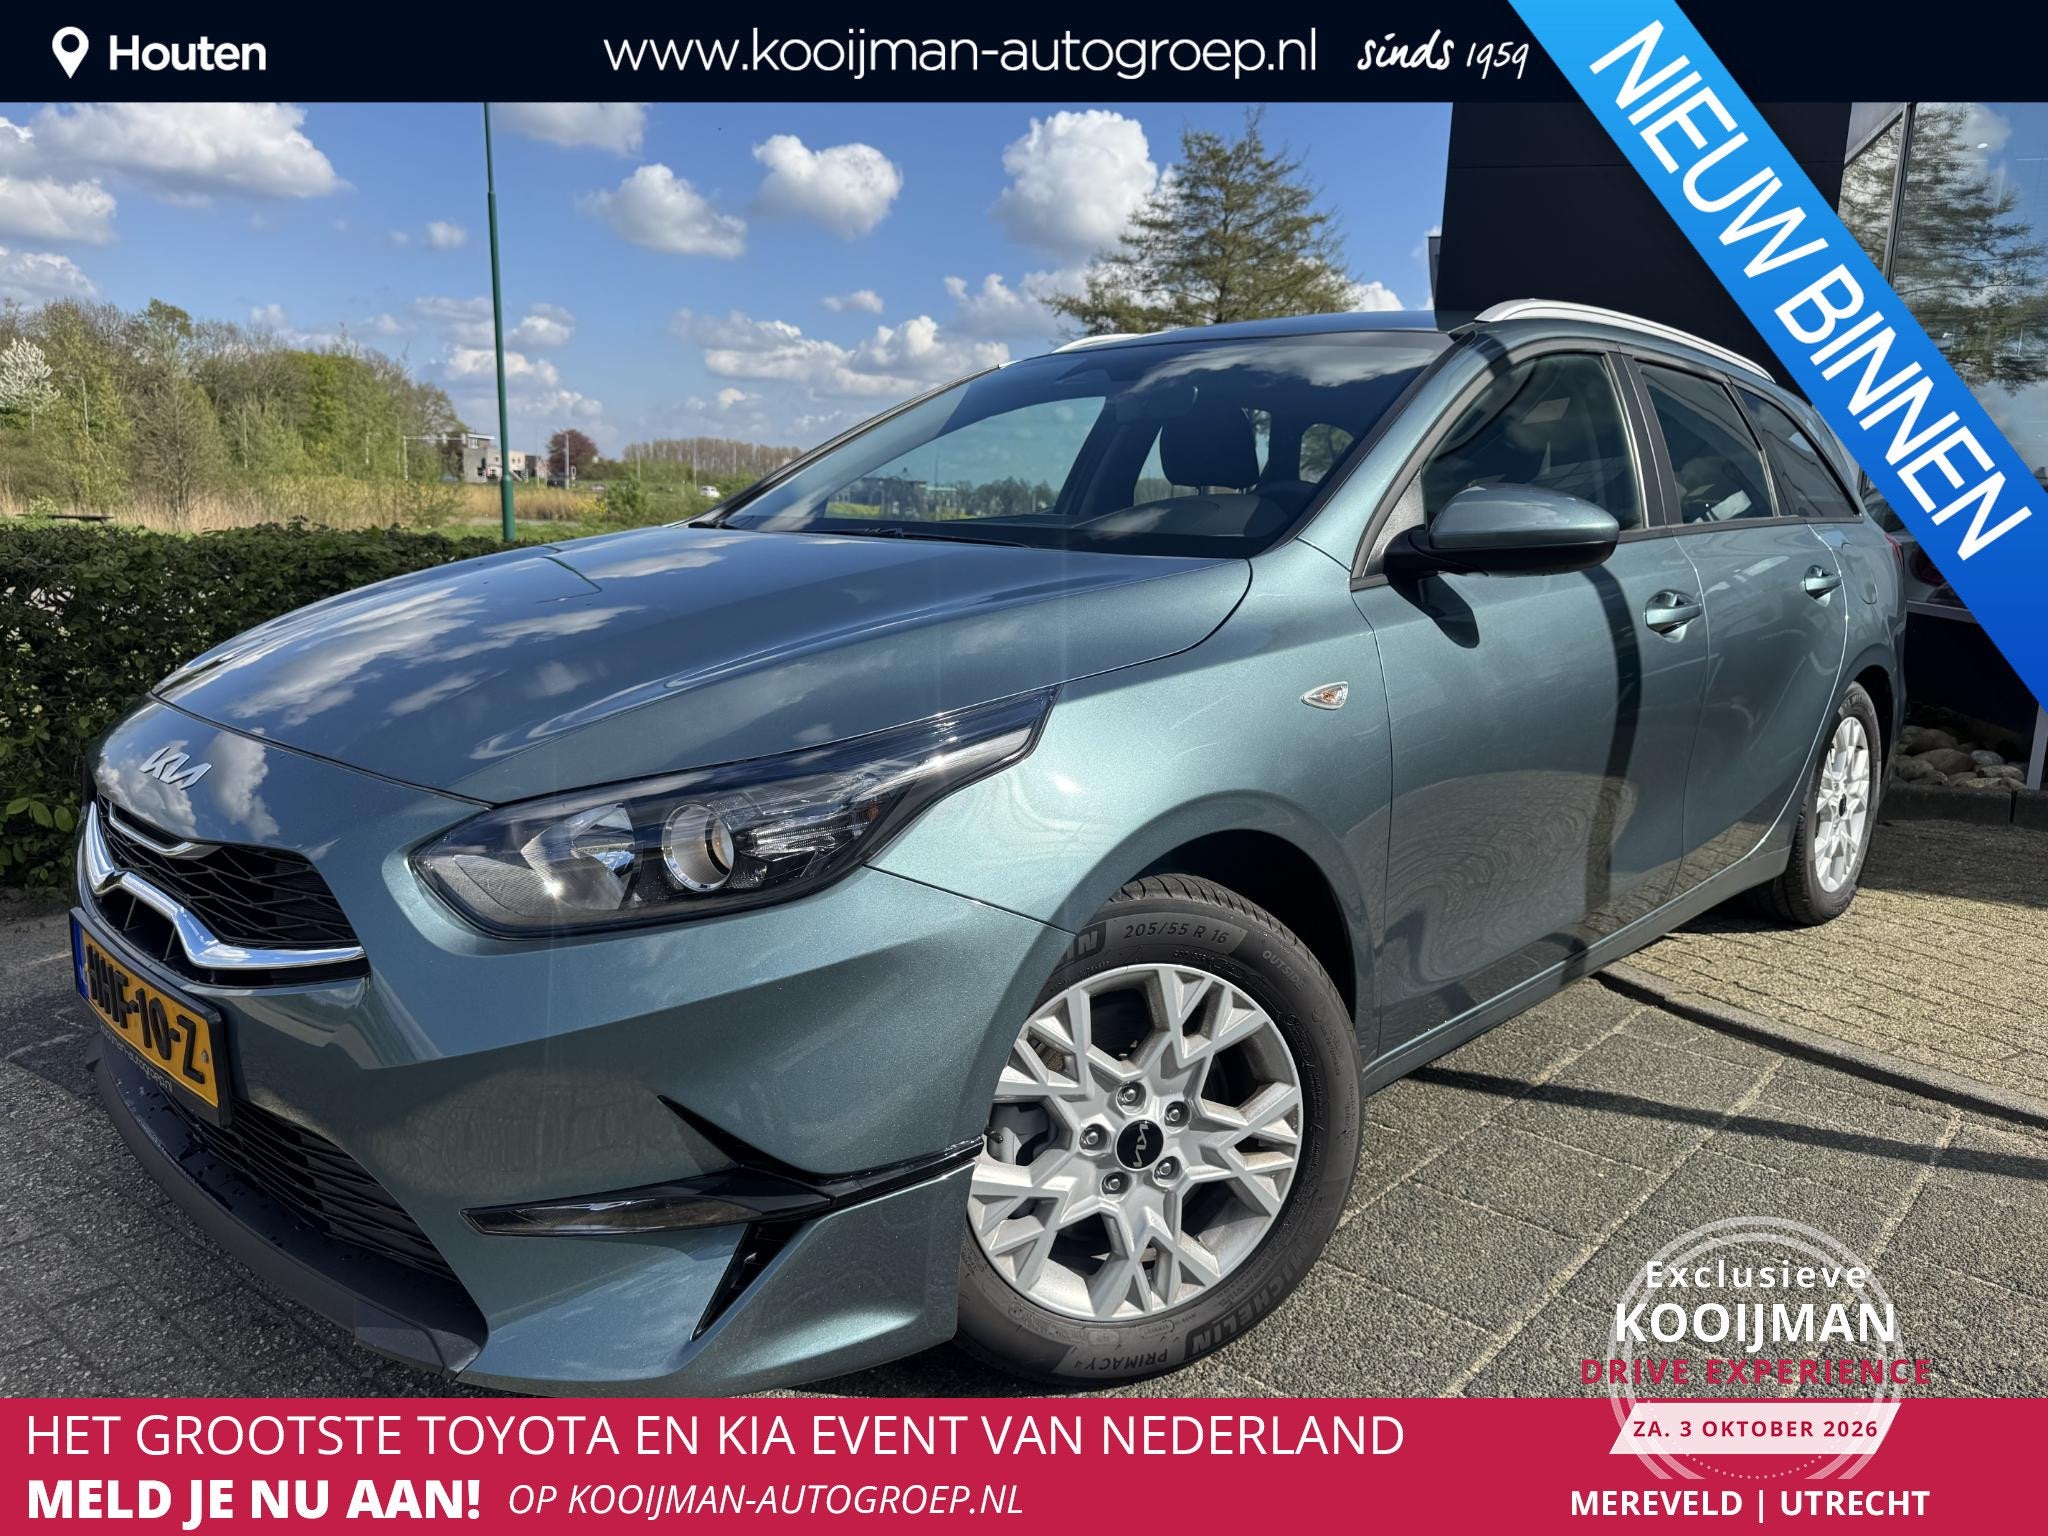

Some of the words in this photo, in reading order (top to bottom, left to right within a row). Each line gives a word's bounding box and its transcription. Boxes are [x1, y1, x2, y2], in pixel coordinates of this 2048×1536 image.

[139, 746, 212, 790] KIA
[1122, 921, 1190, 939] 205/55
[1193, 926, 1209, 939] R
[1211, 929, 1230, 944] 16
[1261, 949, 1306, 991] OUTSIDE
[1084, 1348, 1169, 1370] PRIMACY
